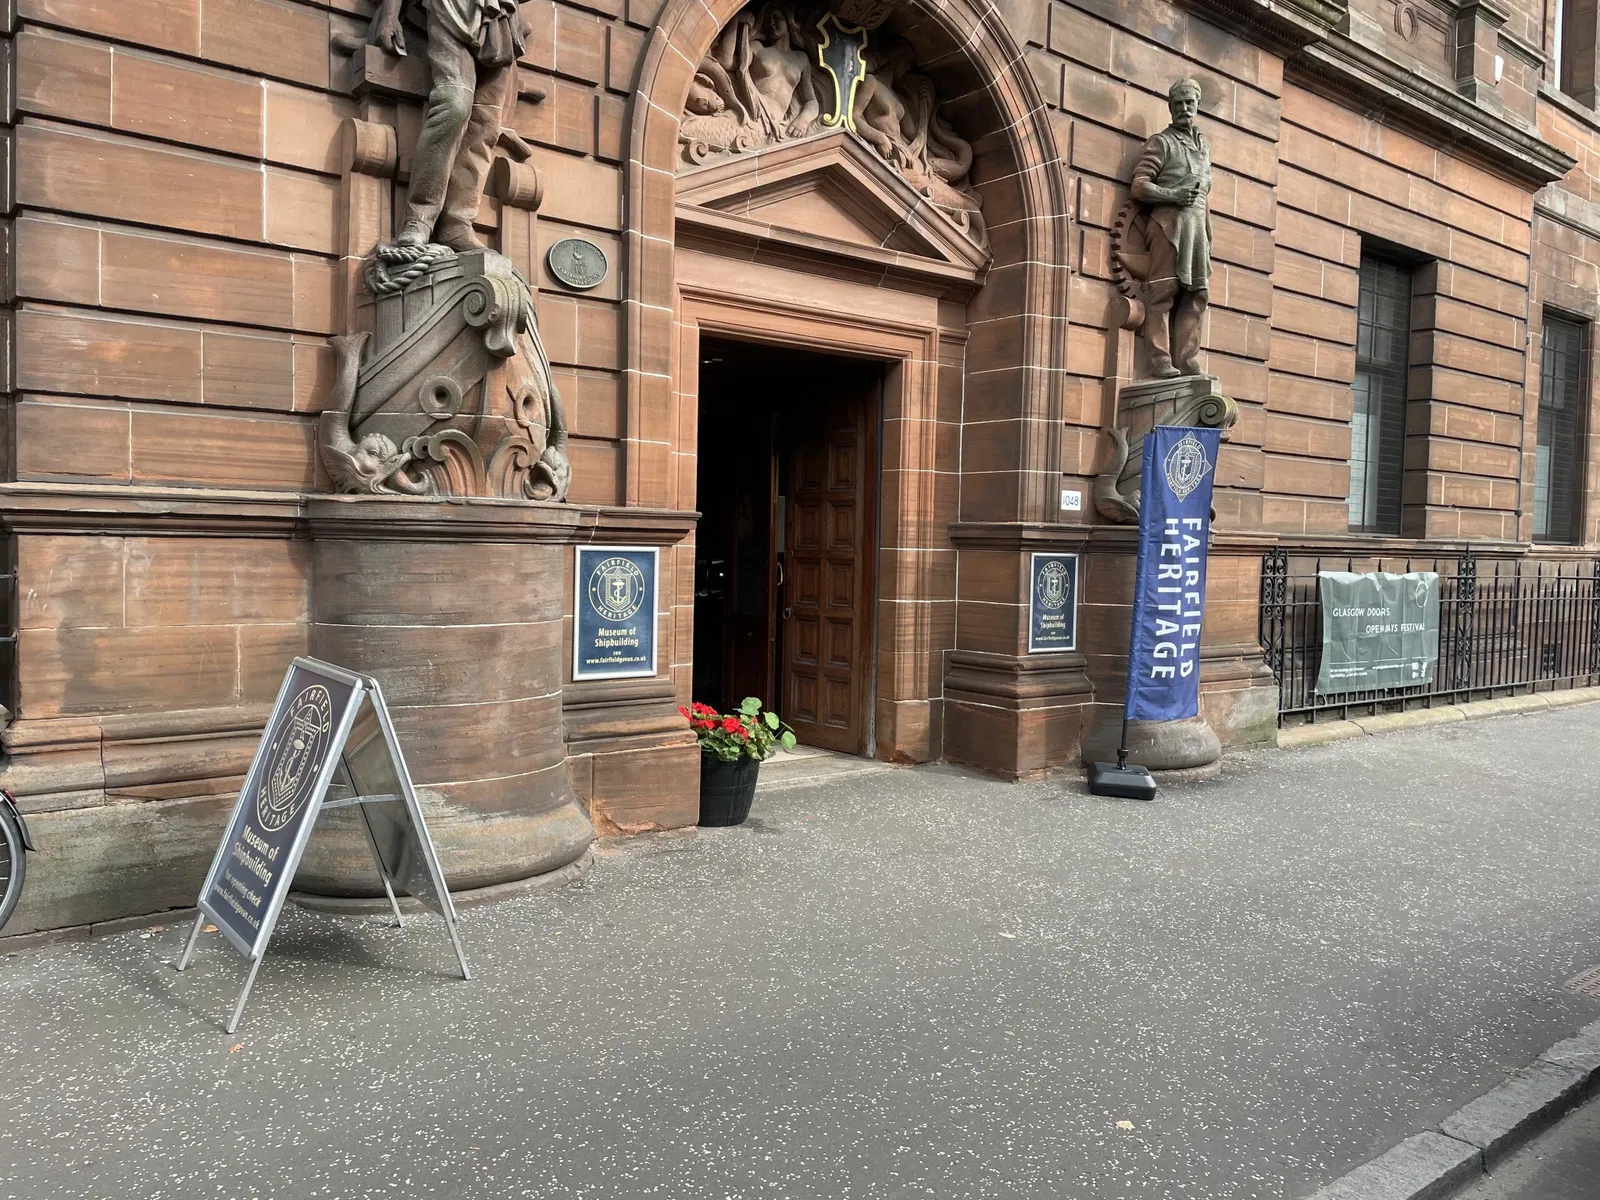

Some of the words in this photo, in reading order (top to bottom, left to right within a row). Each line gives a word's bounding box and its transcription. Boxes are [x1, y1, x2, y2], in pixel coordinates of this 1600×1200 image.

[1062, 495, 1079, 506] 1048
[596, 560, 639, 576] FAIRFIELD
[1150, 518, 1182, 679] HERITAGE
[1180, 518, 1202, 678] FAIRFIELD
[597, 605, 637, 619] HERITAGE
[1332, 608, 1365, 617] GLASGOW
[1367, 608, 1391, 616] DOORS
[598, 628, 628, 637] Museum
[629, 627, 636, 636] of
[1040, 621, 1066, 630] Shipbuilding
[1401, 622, 1425, 632] FESTIVAL
[594, 637, 639, 648] Shipbuilding
[290, 689, 330, 733] FAIRFIELD
[260, 785, 295, 827] HERITAGE
[242, 824, 269, 857] Museum
[268, 846, 280, 862] of
[232, 841, 273, 888] Shipbuilding
[230, 877, 248, 899] opening
[246, 888, 262, 908] check
